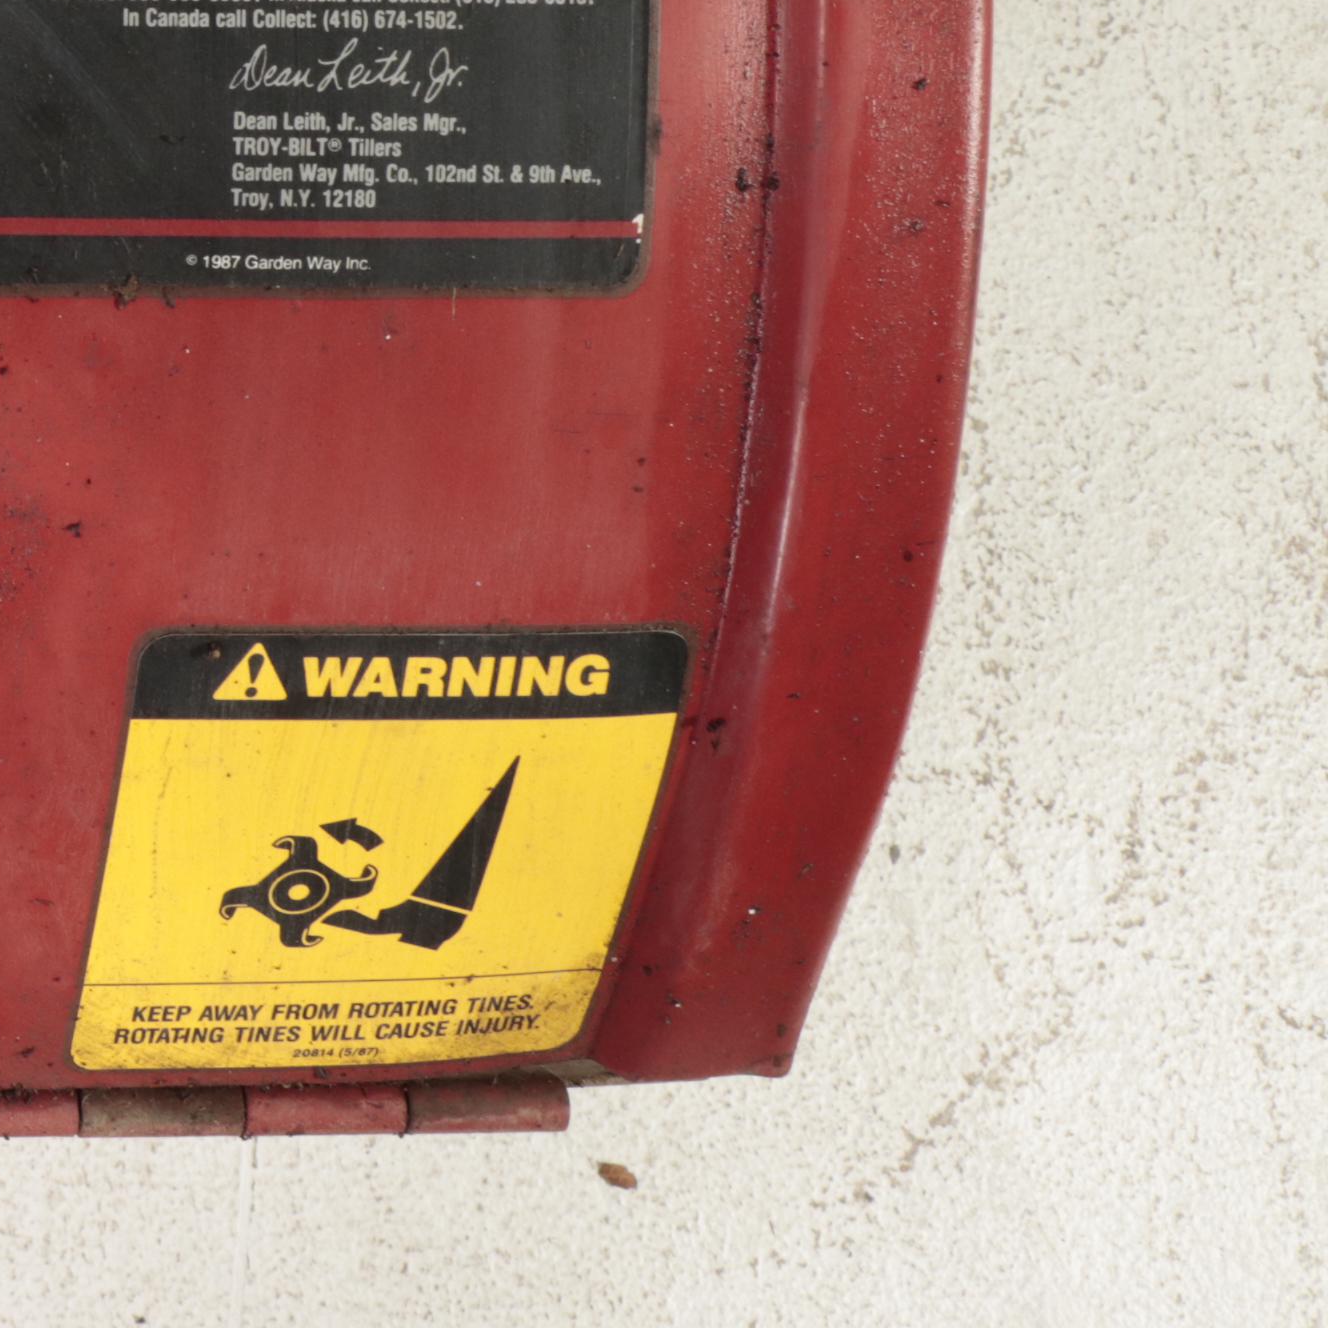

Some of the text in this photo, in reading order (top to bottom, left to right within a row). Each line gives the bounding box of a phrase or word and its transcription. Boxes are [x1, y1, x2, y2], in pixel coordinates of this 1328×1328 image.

[124, 8, 463, 32] In Canada call Collect: (416) 674-1502.
[228, 44, 314, 91] Dean
[424, 47, 468, 103] Jr.
[234, 111, 466, 136] Dean Leith, Jr., Sales Mgr.,
[231, 188, 376, 210] Troy, N.Y. 12180
[204, 255, 240, 269] 1987
[245, 255, 302, 270] Garden
[307, 256, 341, 273] Way
[346, 257, 371, 270] Inc.
[304, 654, 609, 697] WARNING
[132, 994, 534, 1022] KEEP AWAY FROM ROTATING TINES.
[114, 1015, 540, 1044] ROTATING TINES WILL CAUSE INJURY.
